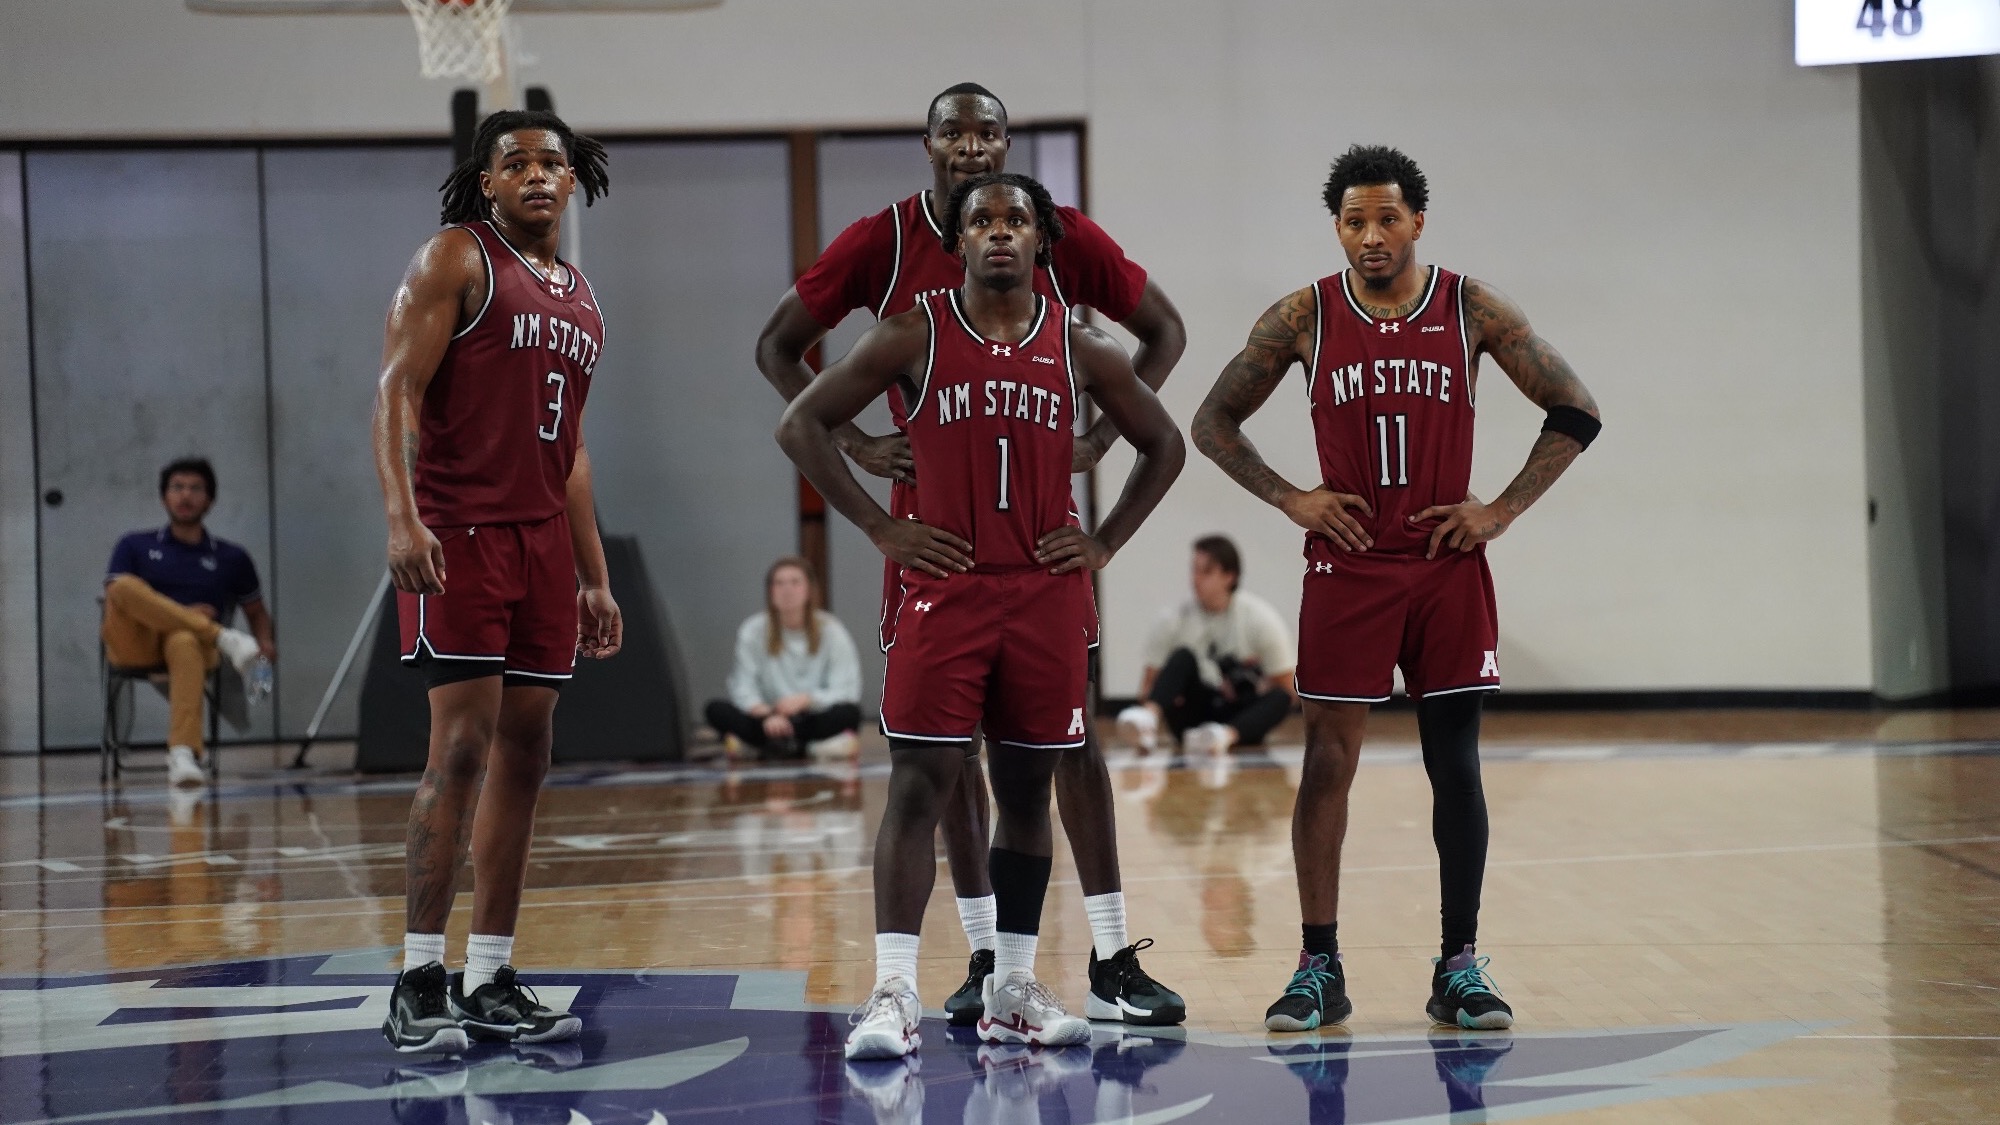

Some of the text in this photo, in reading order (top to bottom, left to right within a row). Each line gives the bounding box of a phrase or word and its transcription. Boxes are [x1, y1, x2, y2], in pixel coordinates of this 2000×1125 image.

[1856, 0, 1923, 37] 48
[511, 313, 598, 376] NM STATE
[538, 371, 566, 442] 3
[937, 380, 1061, 430] NM STATE
[1331, 359, 1452, 406] NM STATE
[998, 437, 1009, 509] 1
[1376, 415, 1408, 486] 11
[1479, 650, 1500, 678] A
[1067, 707, 1085, 736] A
